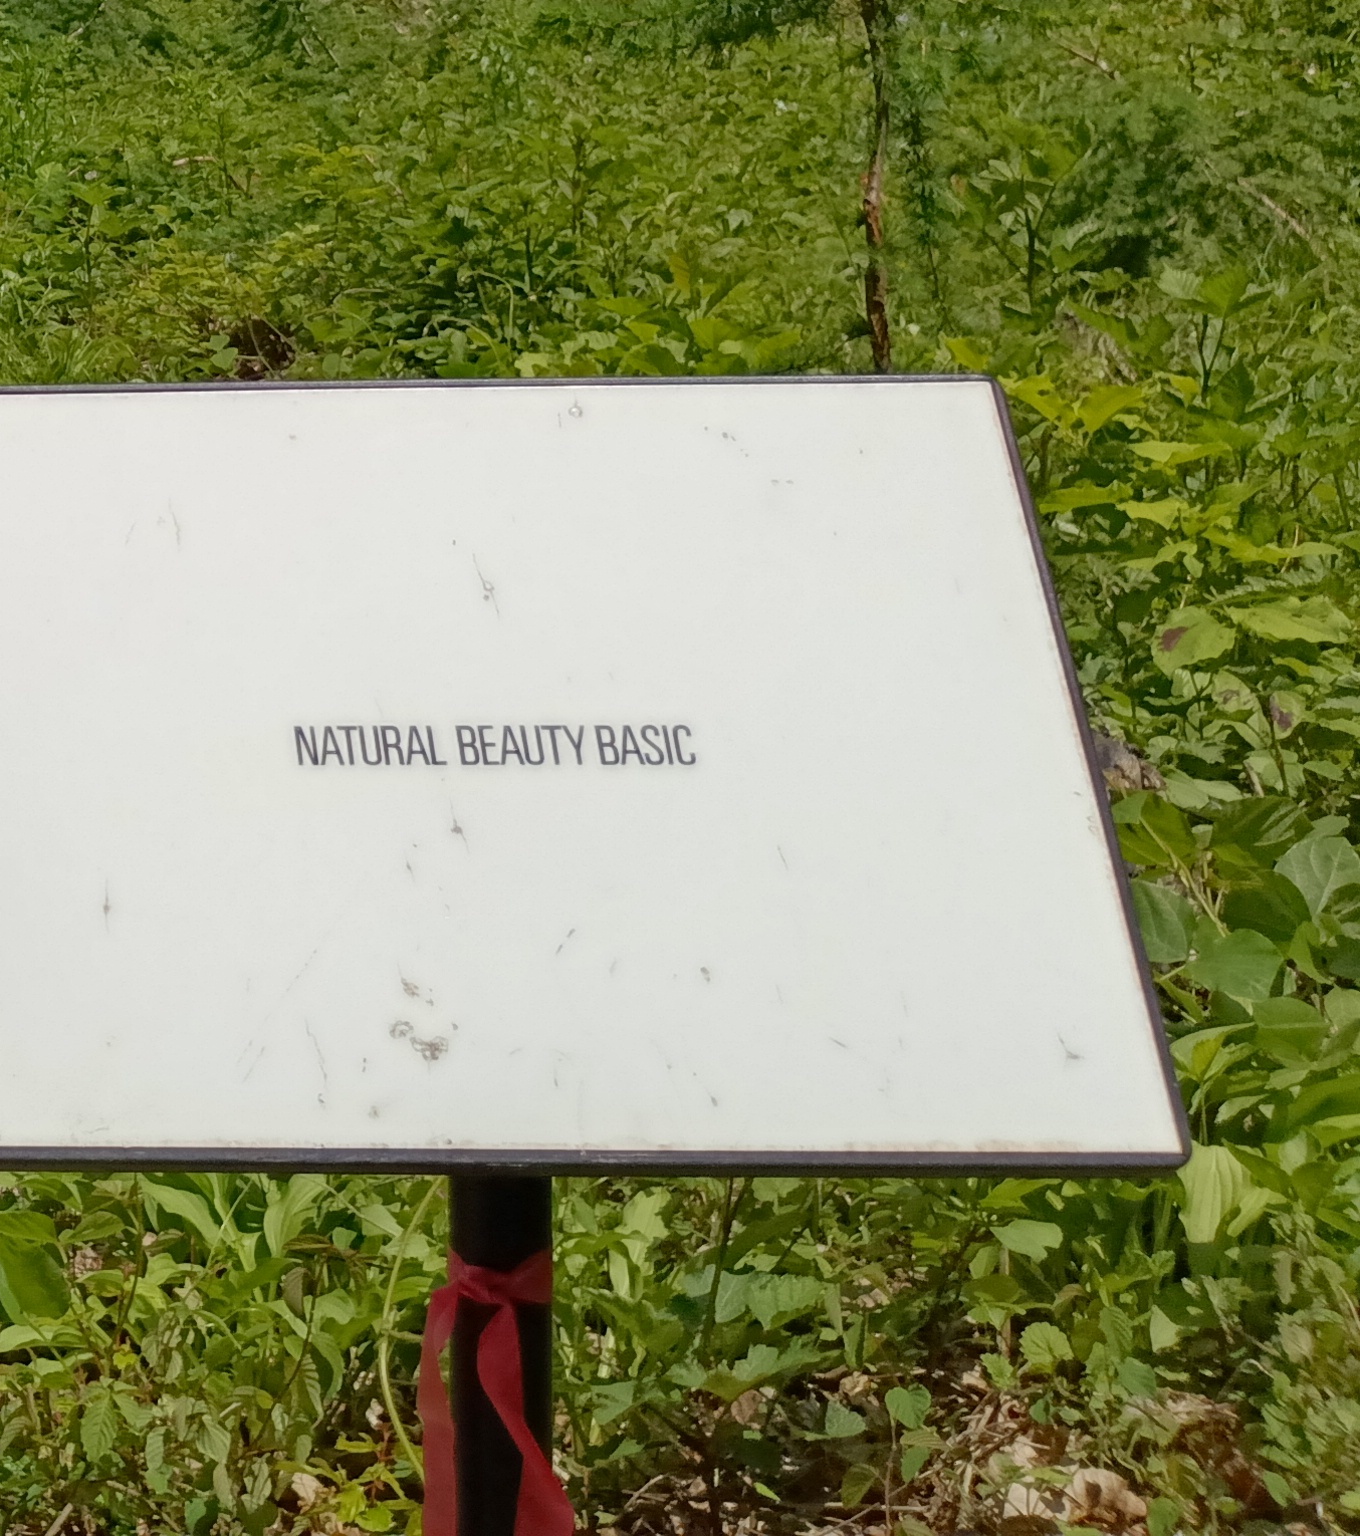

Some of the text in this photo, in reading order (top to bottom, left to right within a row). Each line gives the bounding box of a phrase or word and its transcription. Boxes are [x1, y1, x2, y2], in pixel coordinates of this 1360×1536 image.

[293, 724, 697, 766] NATURAL BEAUTY BASIC
